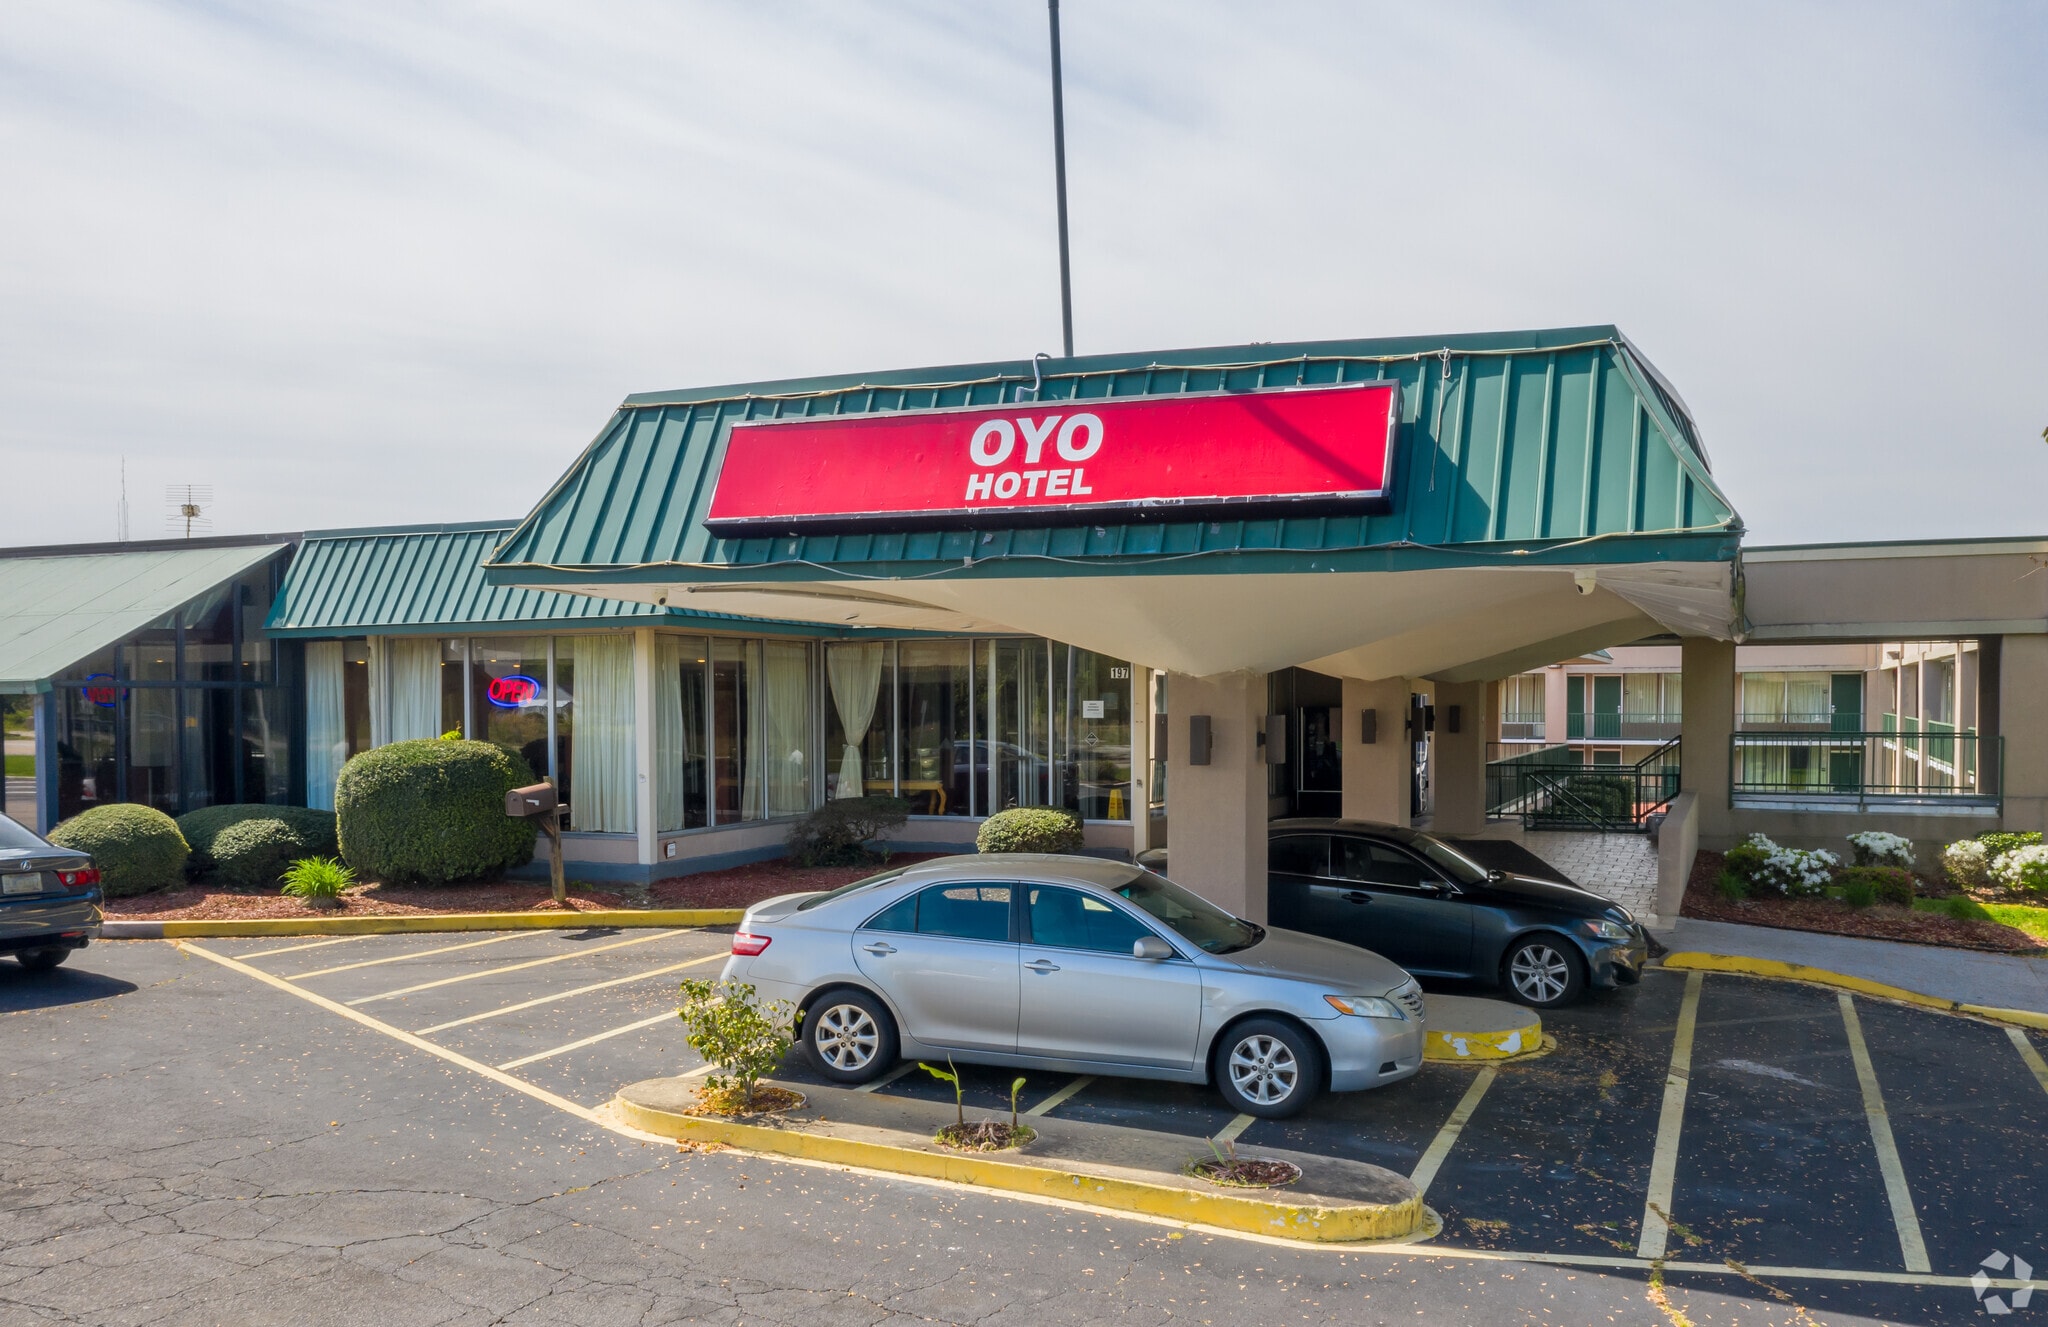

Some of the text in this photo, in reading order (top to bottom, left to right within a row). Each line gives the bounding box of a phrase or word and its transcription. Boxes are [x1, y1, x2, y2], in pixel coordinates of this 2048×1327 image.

[970, 413, 1103, 467] OYO
[965, 468, 1092, 500] HOTEL
[1112, 668, 1128, 678] 197
[489, 678, 534, 704] OPEN
